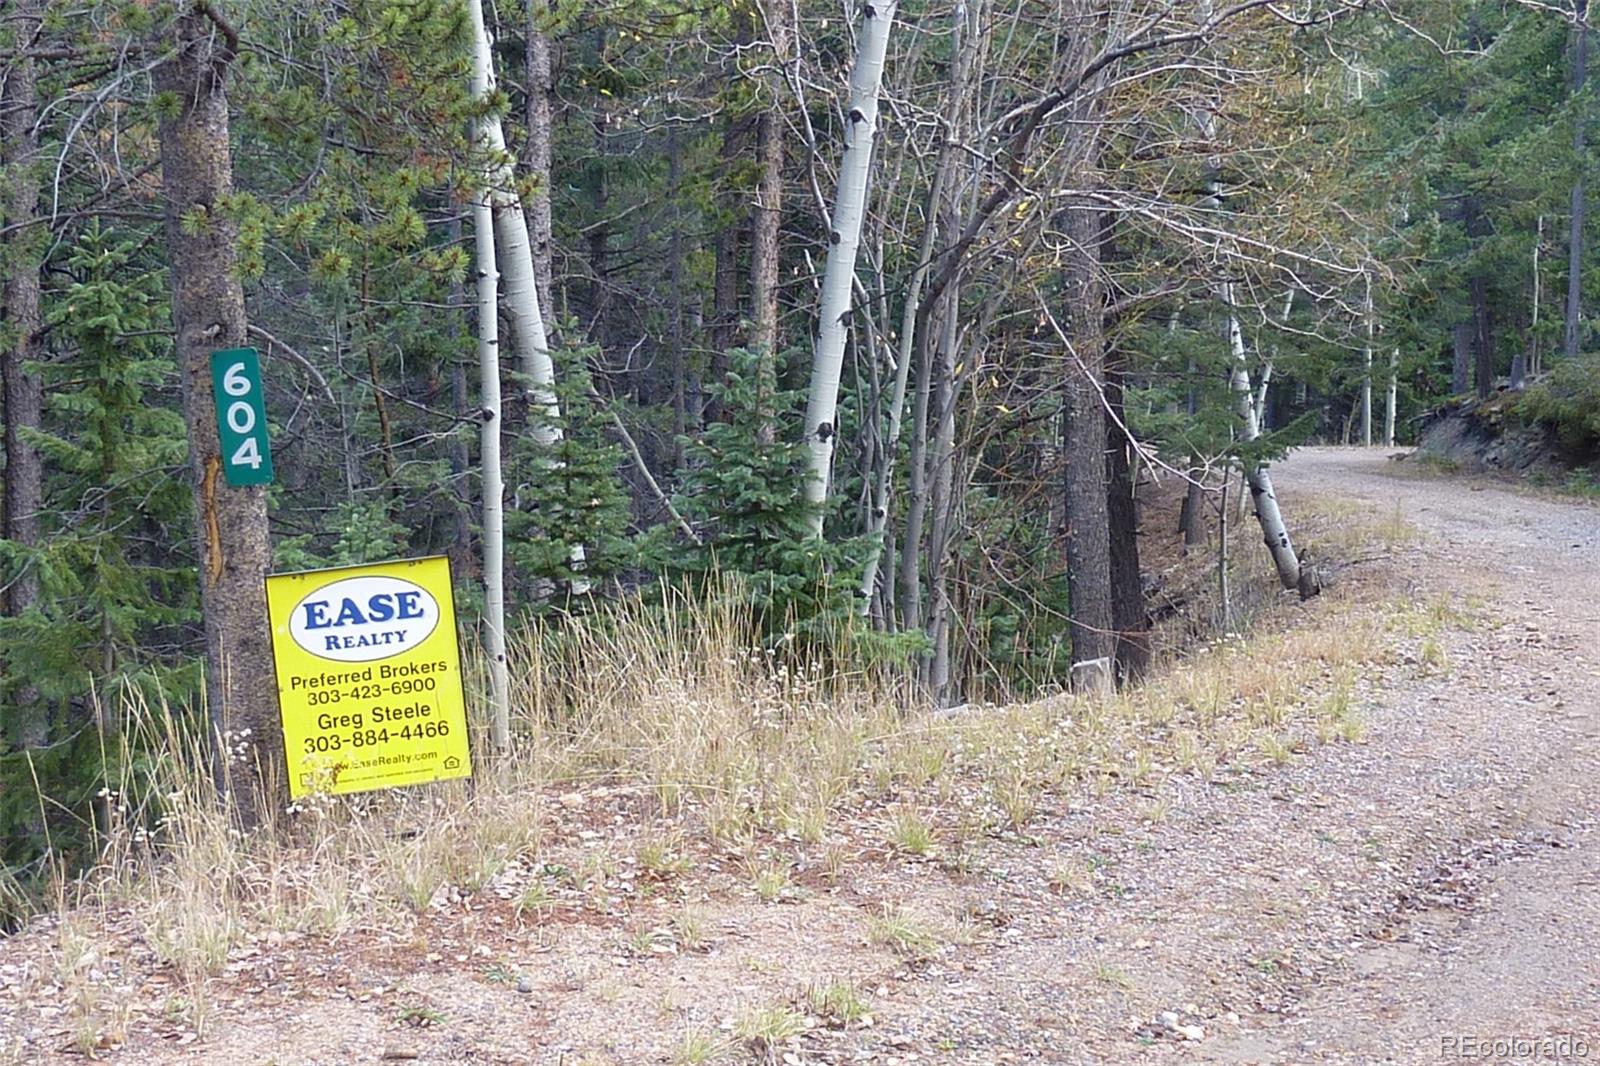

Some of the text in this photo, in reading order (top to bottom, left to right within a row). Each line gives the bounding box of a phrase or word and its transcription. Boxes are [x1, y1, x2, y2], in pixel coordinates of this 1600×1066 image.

[223, 362, 262, 469] 604
[303, 591, 424, 630] EASE
[325, 631, 408, 651] REALTY
[291, 661, 448, 690] Preferred Brokers
[307, 677, 436, 706] 303-423-6900
[318, 702, 431, 731] Greg Steele
[304, 720, 449, 755] 303-884-4466
